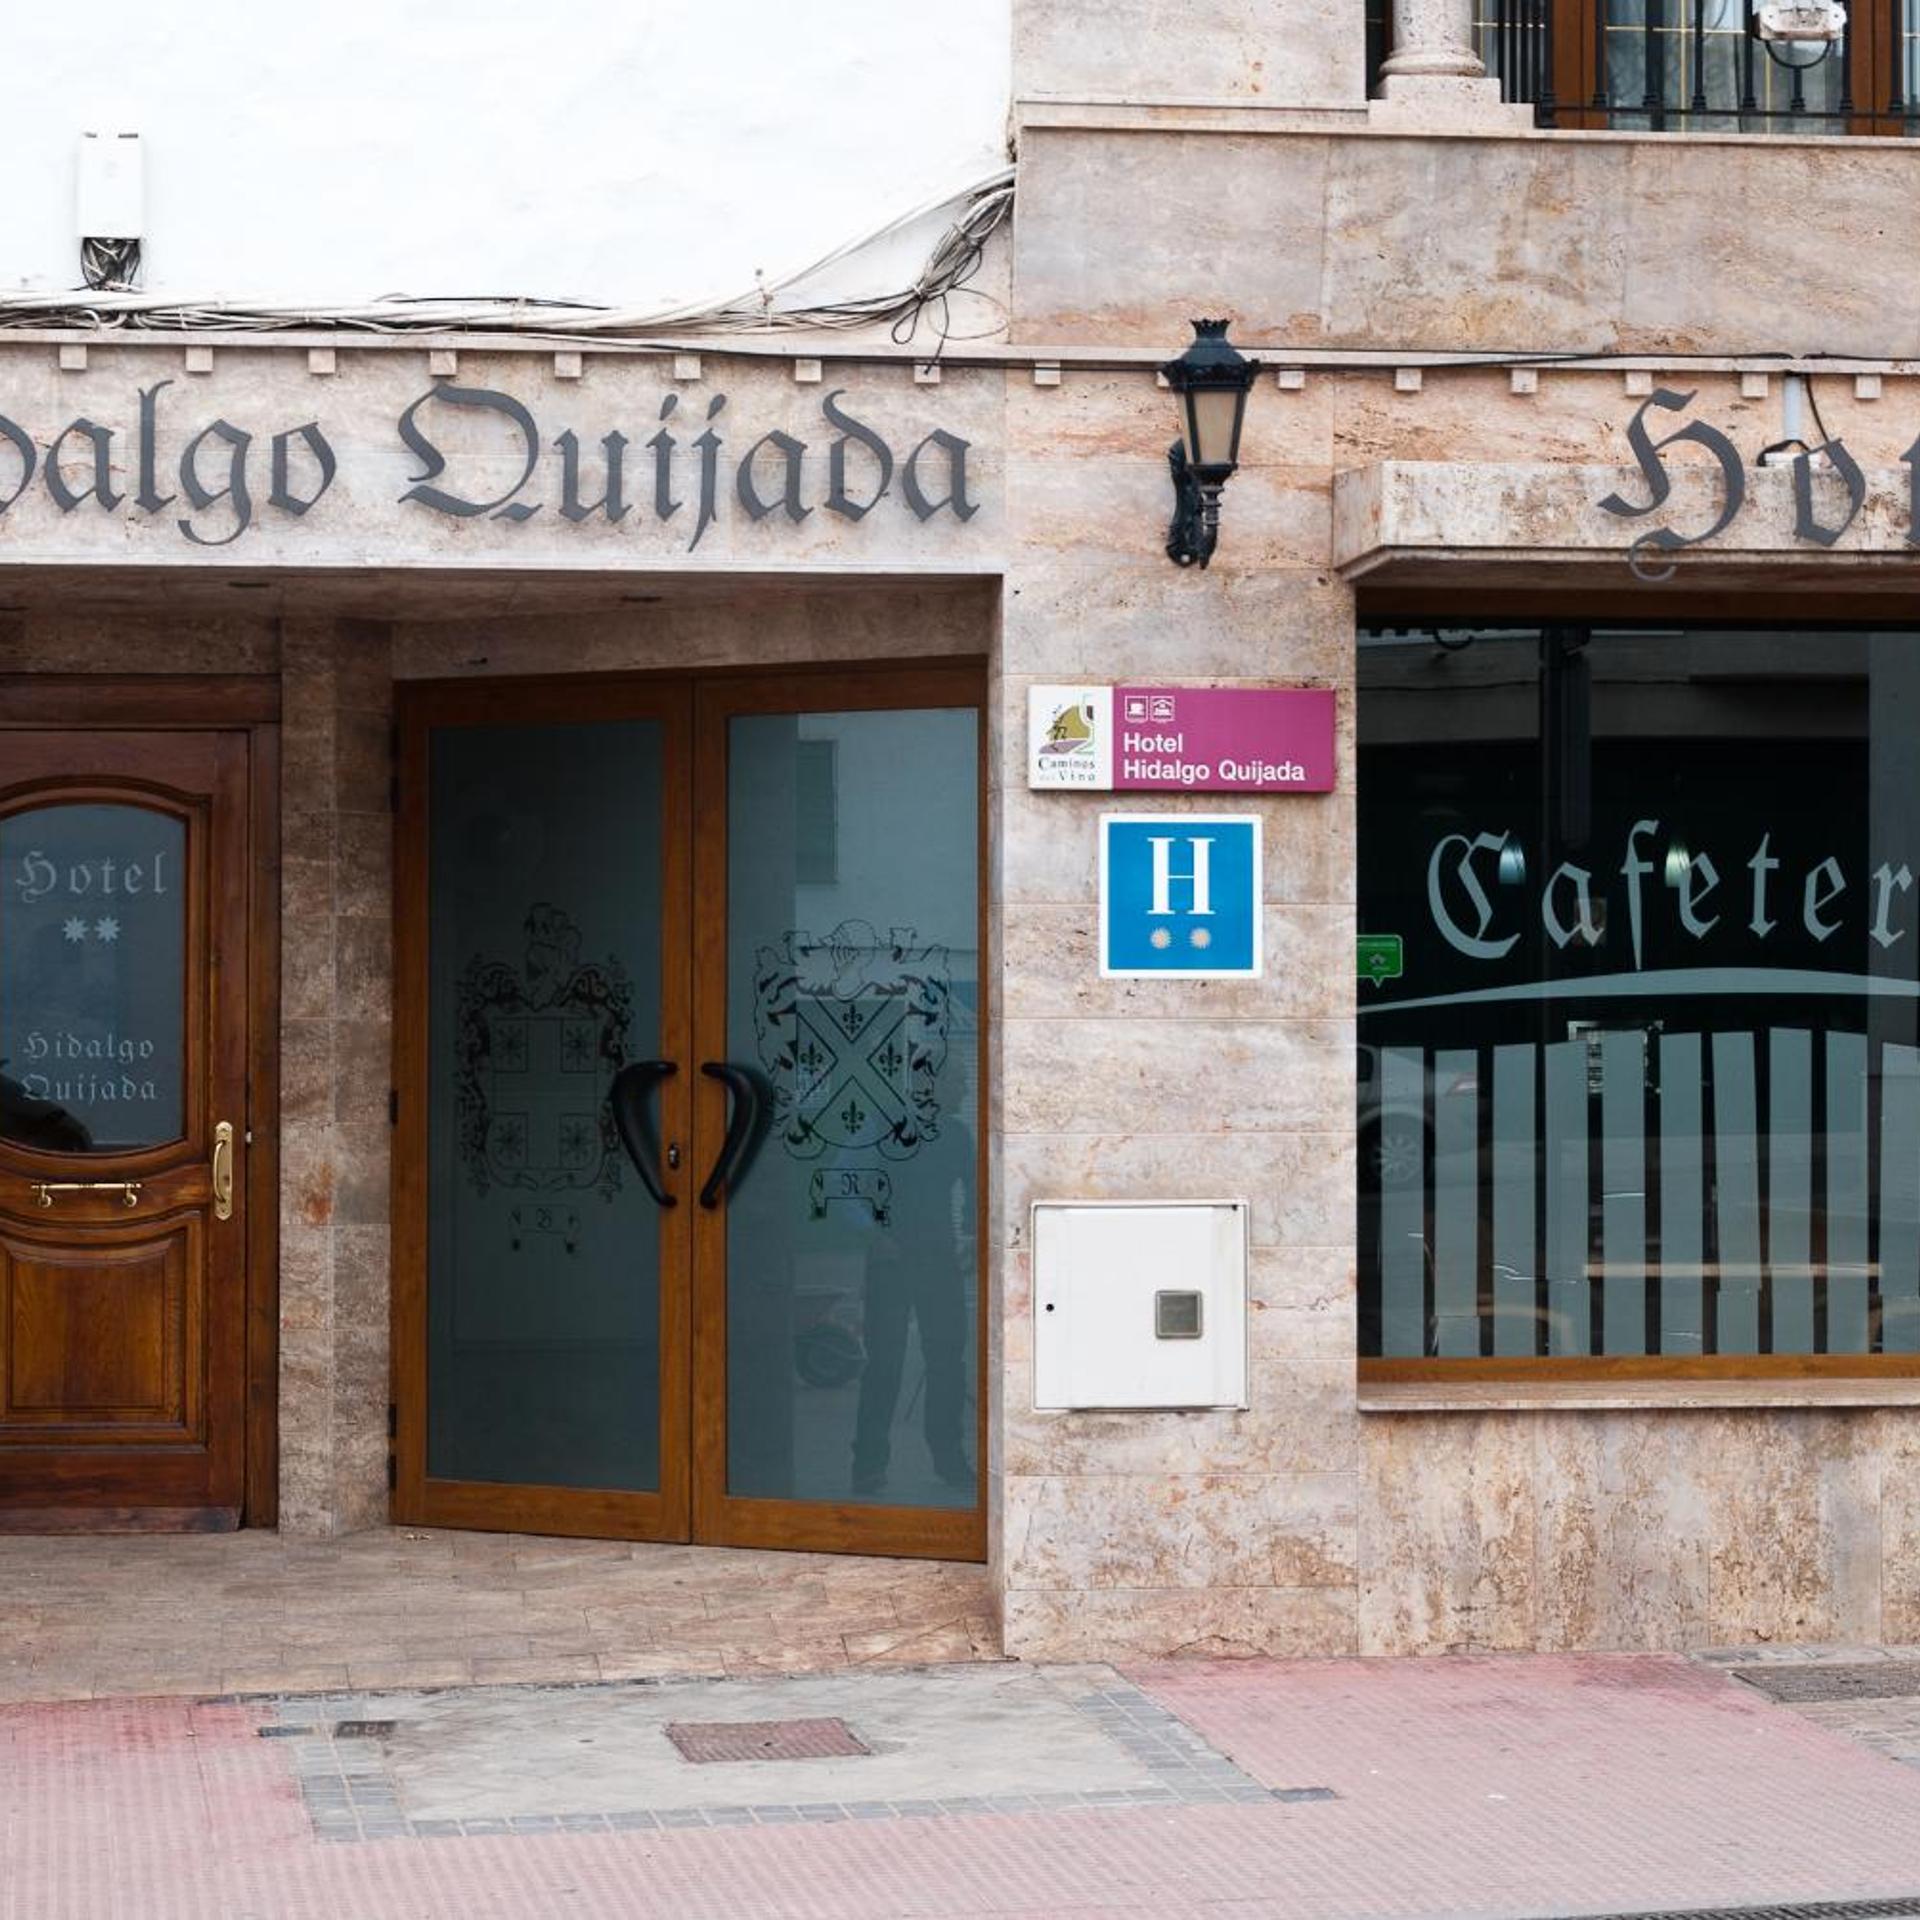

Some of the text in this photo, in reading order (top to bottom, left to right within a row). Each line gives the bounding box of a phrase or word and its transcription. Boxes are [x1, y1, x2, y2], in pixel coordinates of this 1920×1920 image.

[399, 382, 980, 552] Quijada
[1123, 733, 1183, 752] Hotel
[1038, 757, 1095, 770] Caminos
[1059, 771, 1096, 781] Vino
[1123, 759, 1306, 785] Hidalgo Quijada
[16, 850, 168, 903] Hotel
[1147, 837, 1216, 915] H
[1428, 819, 1914, 972] Cafeter
[24, 1031, 156, 1064] Hidalgo
[22, 1072, 157, 1104] Quijada
